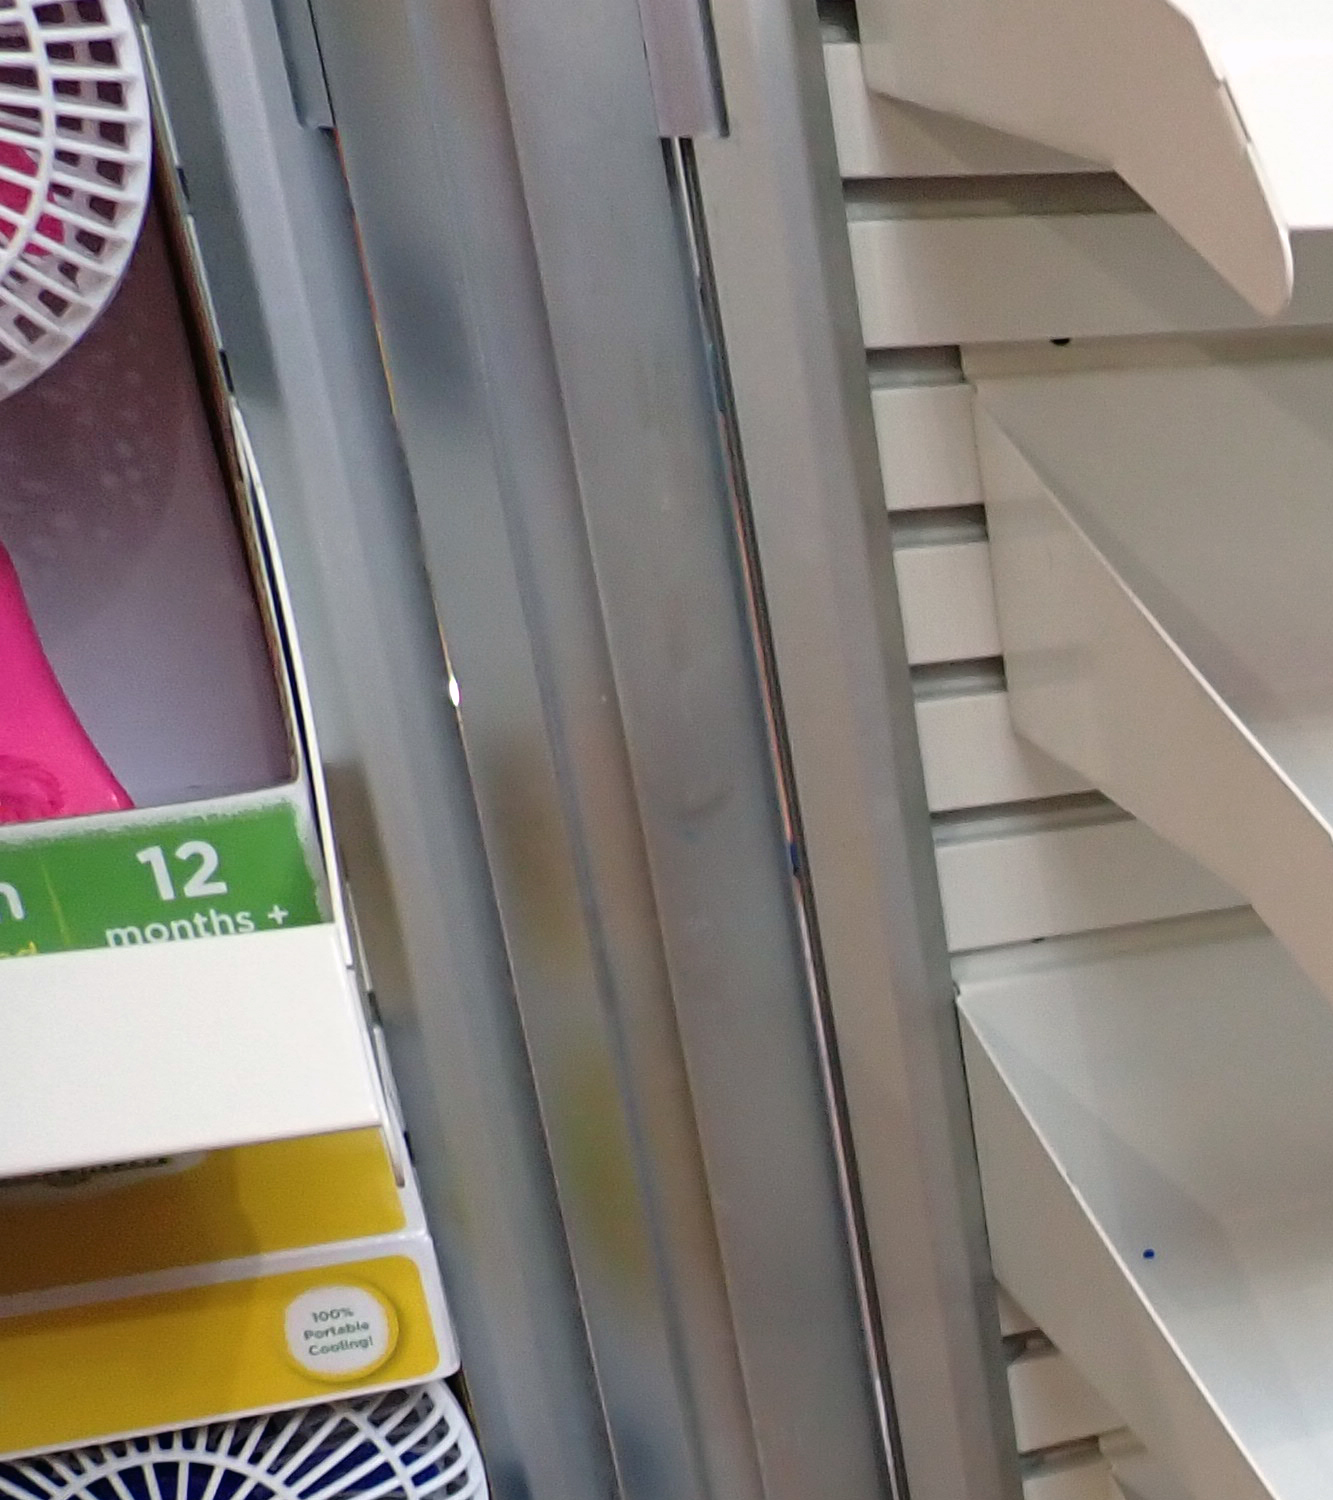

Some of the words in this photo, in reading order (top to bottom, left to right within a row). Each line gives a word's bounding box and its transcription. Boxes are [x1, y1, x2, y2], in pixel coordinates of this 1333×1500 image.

[135, 840, 229, 902] 12
[105, 907, 255, 948] months
[311, 1307, 354, 1323] 100%
[303, 1321, 370, 1341] Portable
